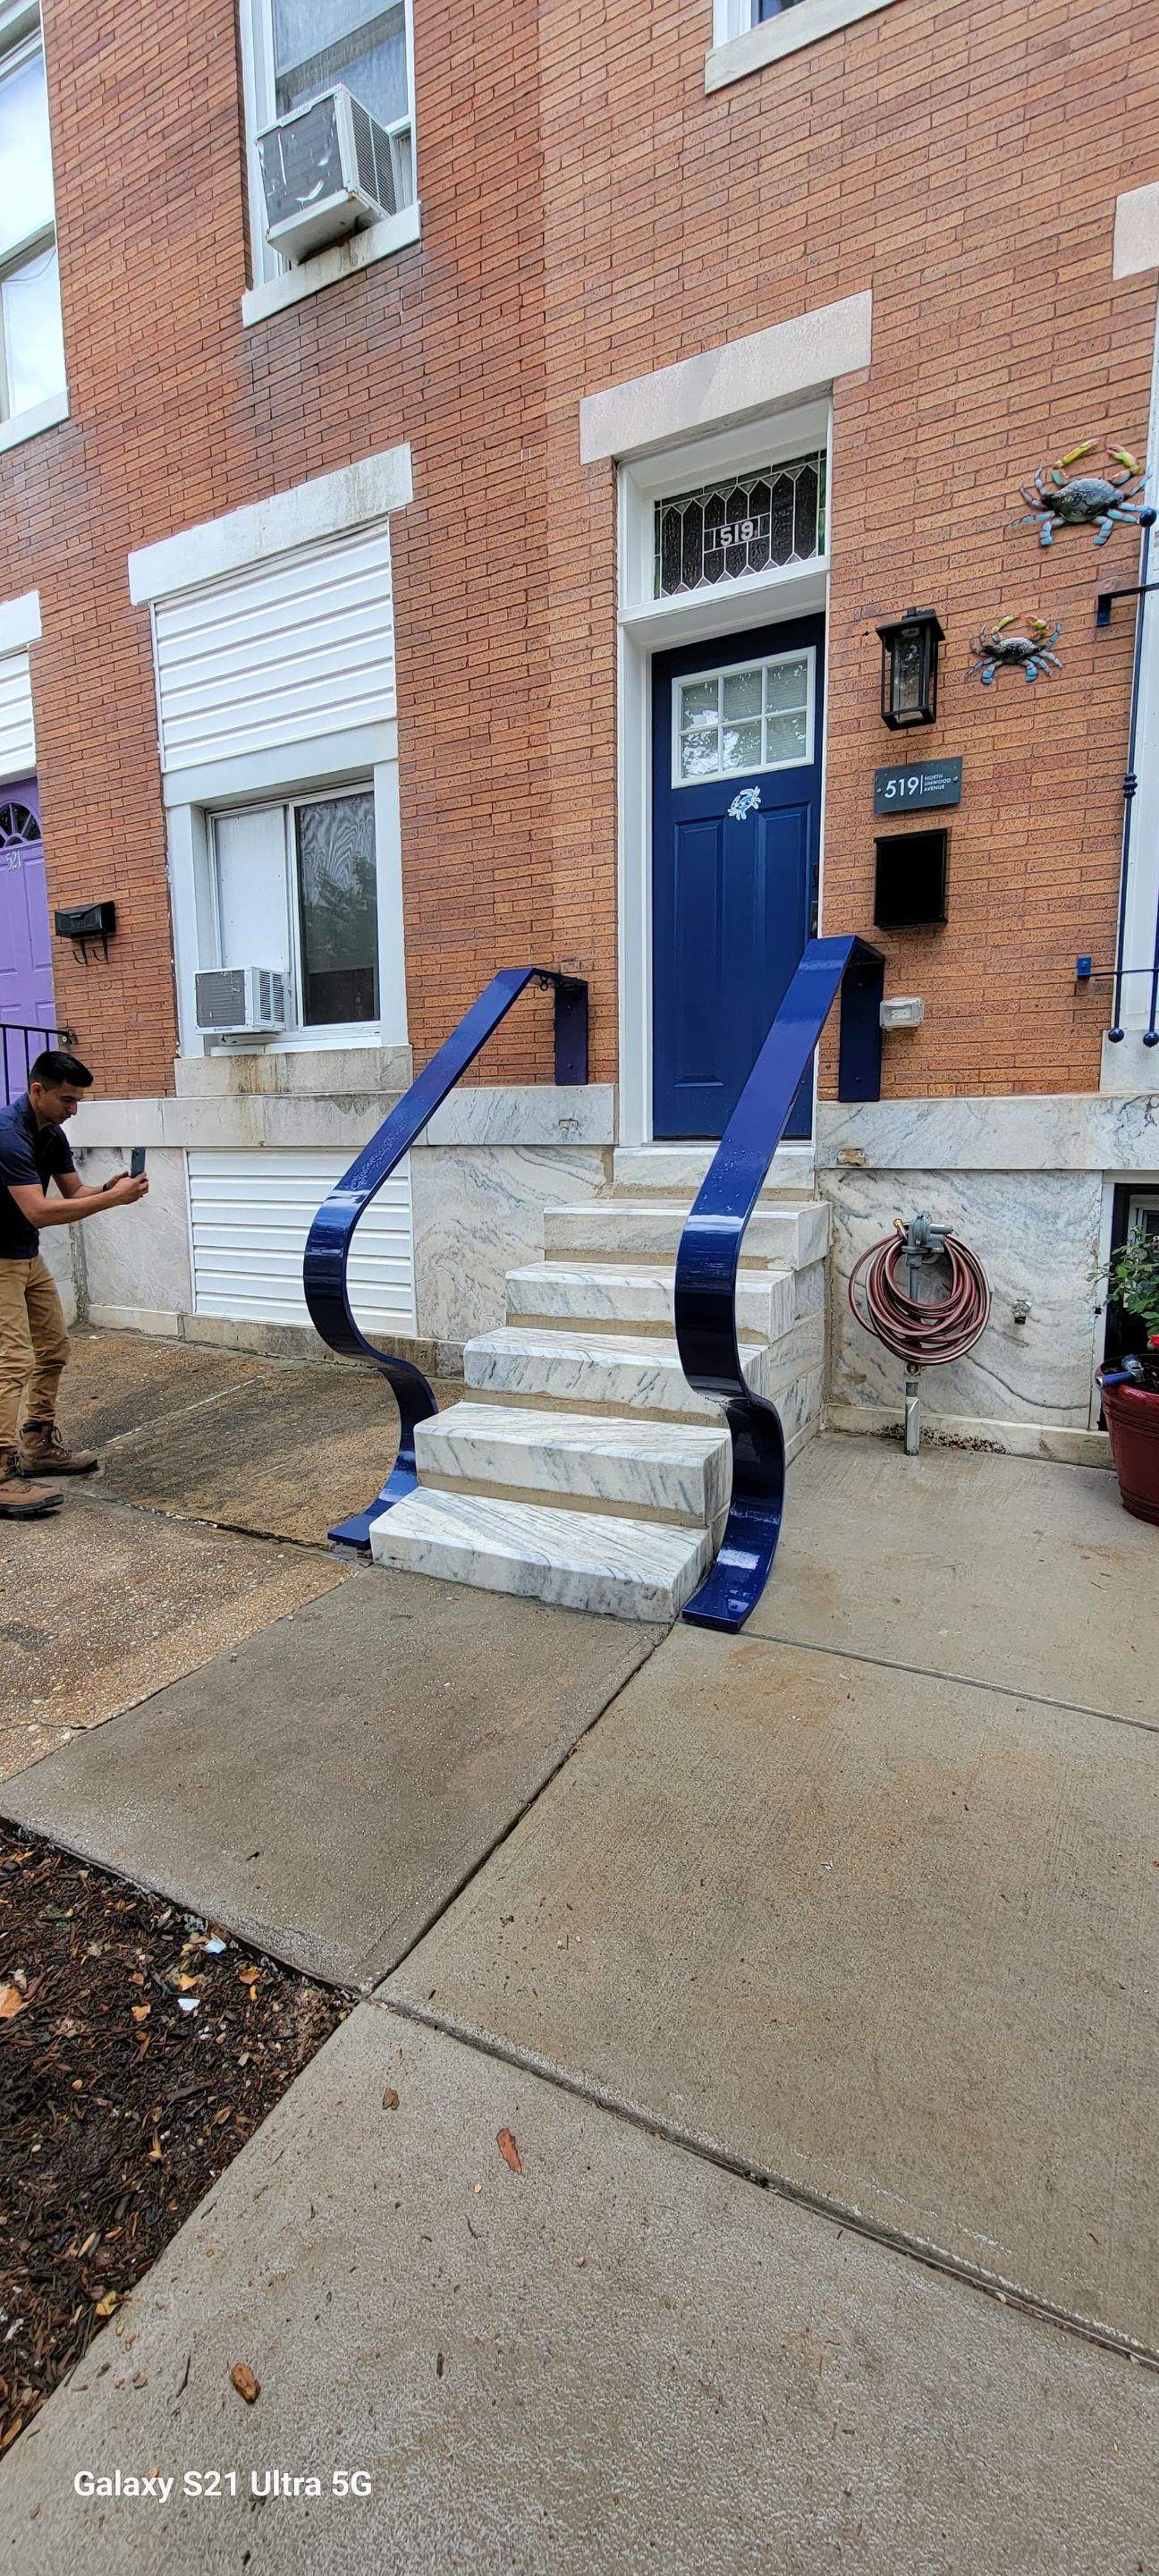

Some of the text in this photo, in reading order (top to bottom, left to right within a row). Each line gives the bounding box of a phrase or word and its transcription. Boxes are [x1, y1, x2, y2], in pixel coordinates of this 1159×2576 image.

[720, 521, 754, 547] 519
[884, 776, 919, 799] 519
[924, 773, 943, 781] NORTH
[924, 784, 945, 792] AVENUE
[6, 850, 21, 871] 521
